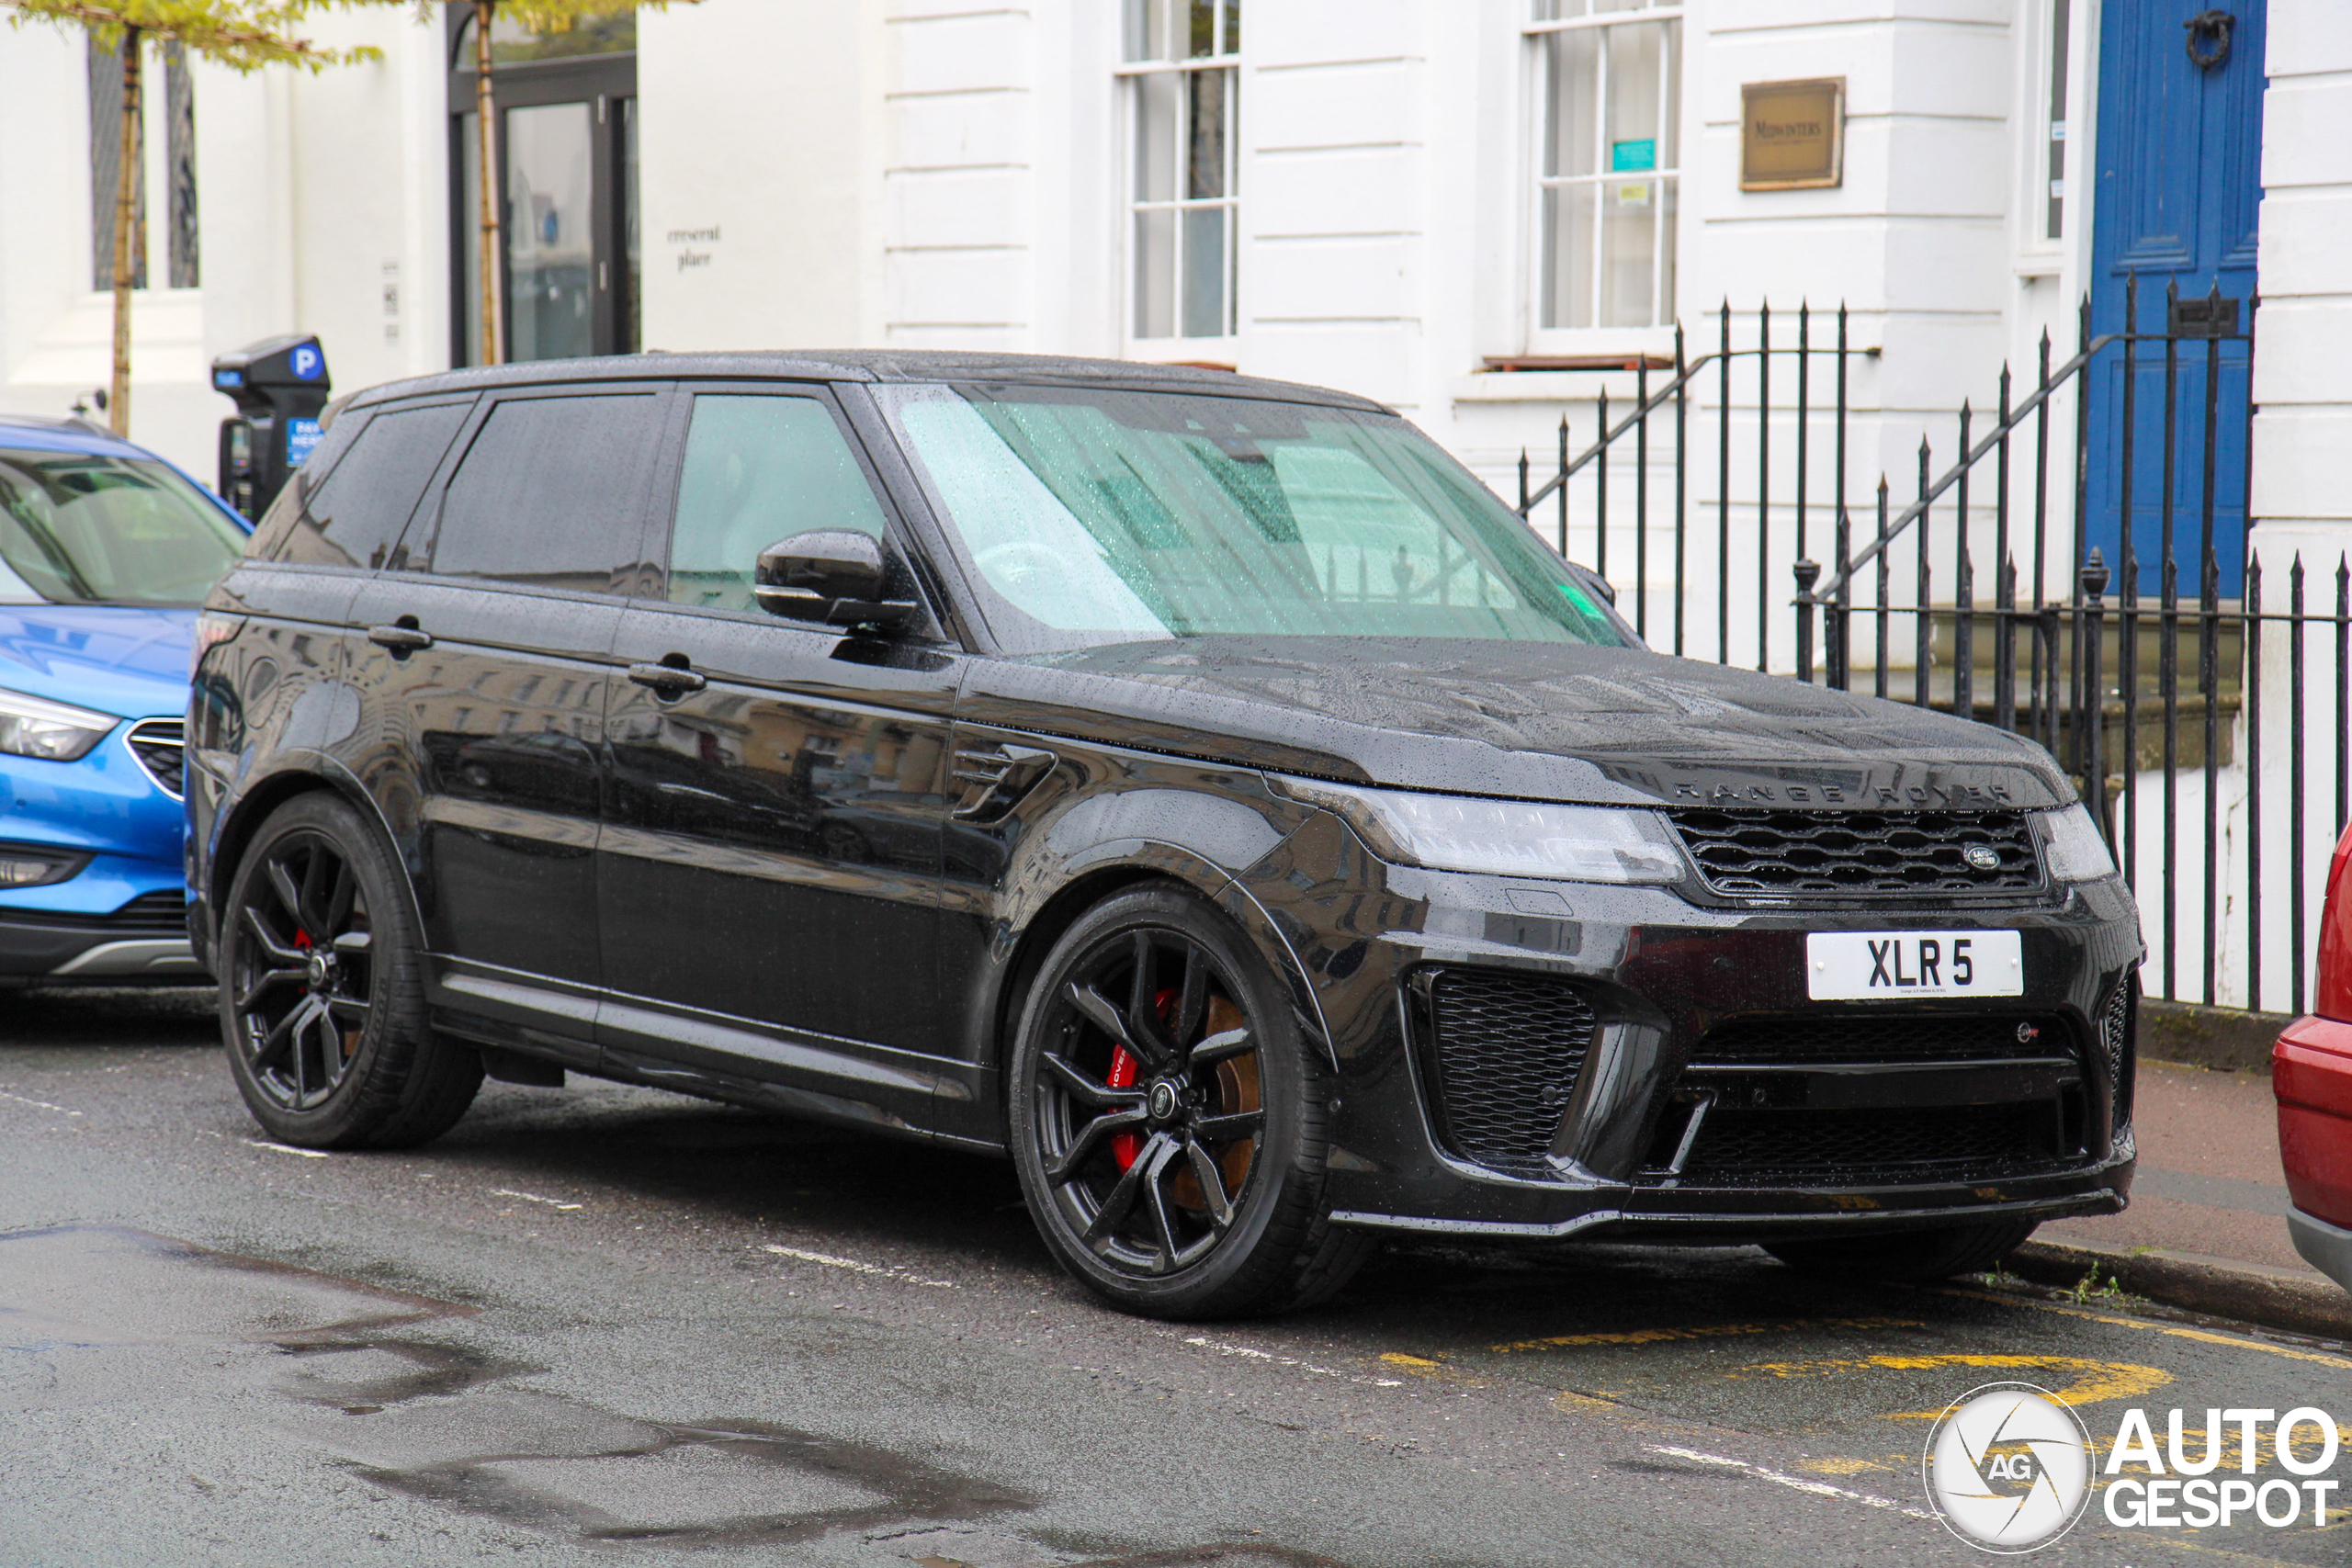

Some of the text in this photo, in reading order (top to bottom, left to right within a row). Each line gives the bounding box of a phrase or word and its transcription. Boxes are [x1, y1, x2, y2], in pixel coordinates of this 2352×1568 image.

[678, 246, 711, 273] place
[296, 348, 317, 375] P
[1671, 782, 2013, 803] RANGE ROVER
[1973, 850, 1989, 858] LAND
[1977, 856, 1996, 865] ROVER
[1868, 939, 1973, 987] XLR 5
